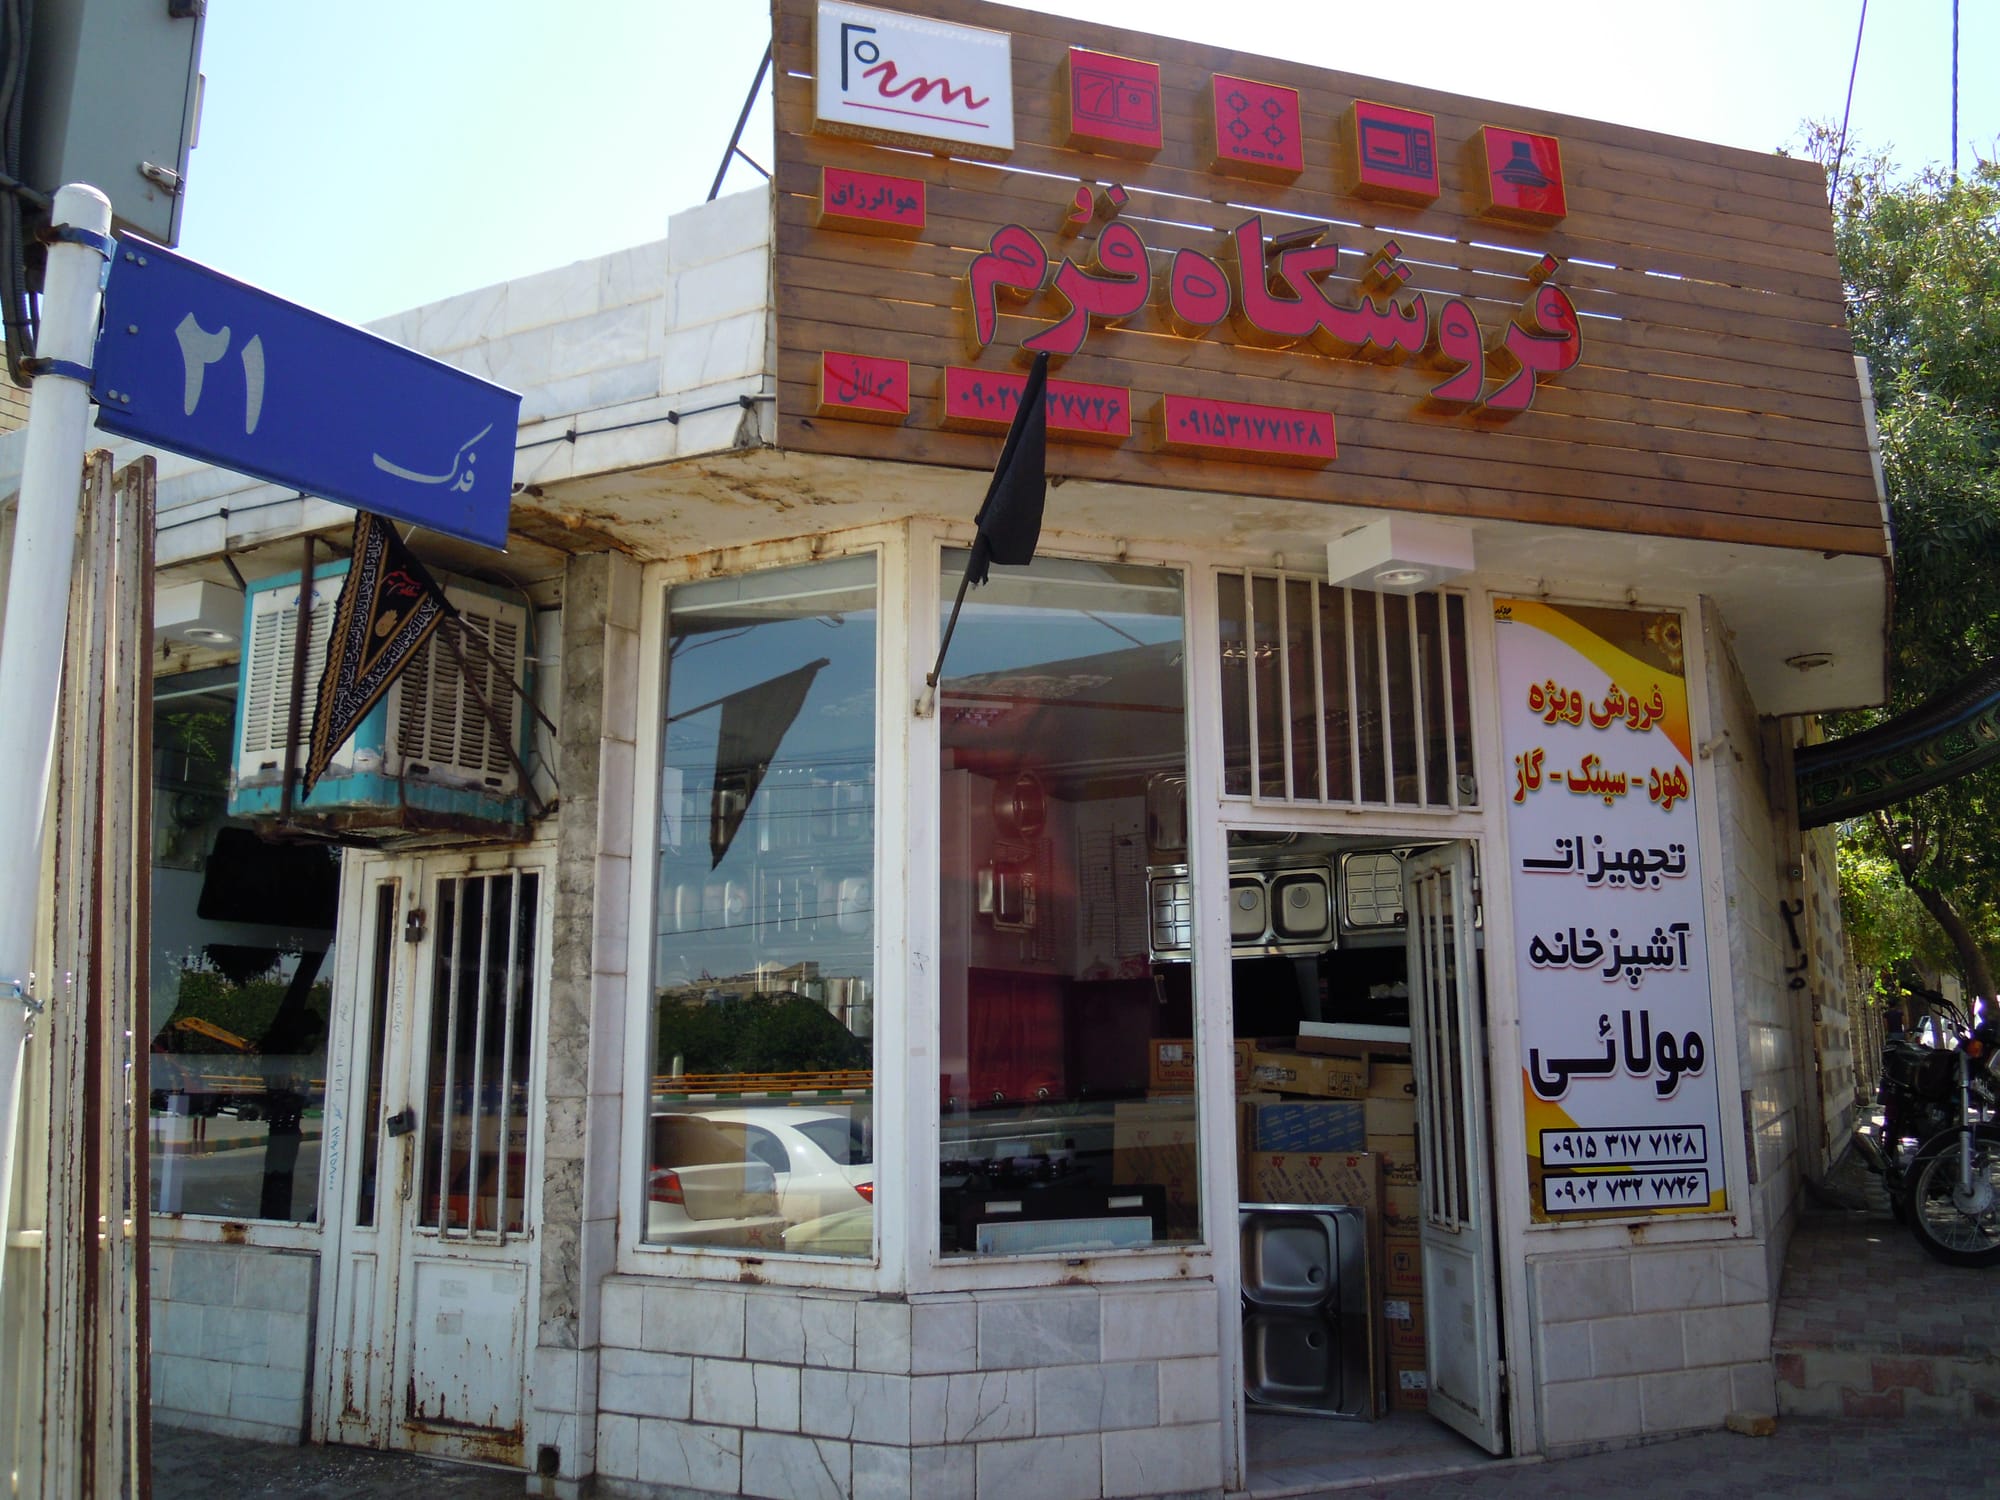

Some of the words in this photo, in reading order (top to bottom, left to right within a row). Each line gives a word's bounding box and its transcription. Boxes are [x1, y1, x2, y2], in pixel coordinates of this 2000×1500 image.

[1169, 214, 1584, 412] فروشگاه
[174, 312, 266, 435] ۲۱
[1180, 409, 1322, 447] ۰۹۱۵۳۱۷۷۱۴۸
[373, 423, 493, 493] فدک
[1528, 679, 1583, 725] ویژه
[1589, 683, 1665, 729] فروش
[1513, 748, 1544, 802] گاز
[1567, 754, 1627, 804] سینک
[1648, 764, 1688, 810] هود
[1521, 834, 1687, 886] تجهیزات
[1529, 922, 1690, 985] آشپزخانه
[1529, 1010, 1705, 1097] مولائی
[1552, 1135, 1597, 1159] ۰۹۱۵
[1605, 1134, 1641, 1157] ۳۱۷
[1650, 1132, 1697, 1156] ۷۱۴۸
[1555, 1179, 1598, 1204] ۰۹۰۲
[1605, 1177, 1643, 1200] ۷۳۲
[1651, 1175, 1699, 1198] ۷۷۲۶
